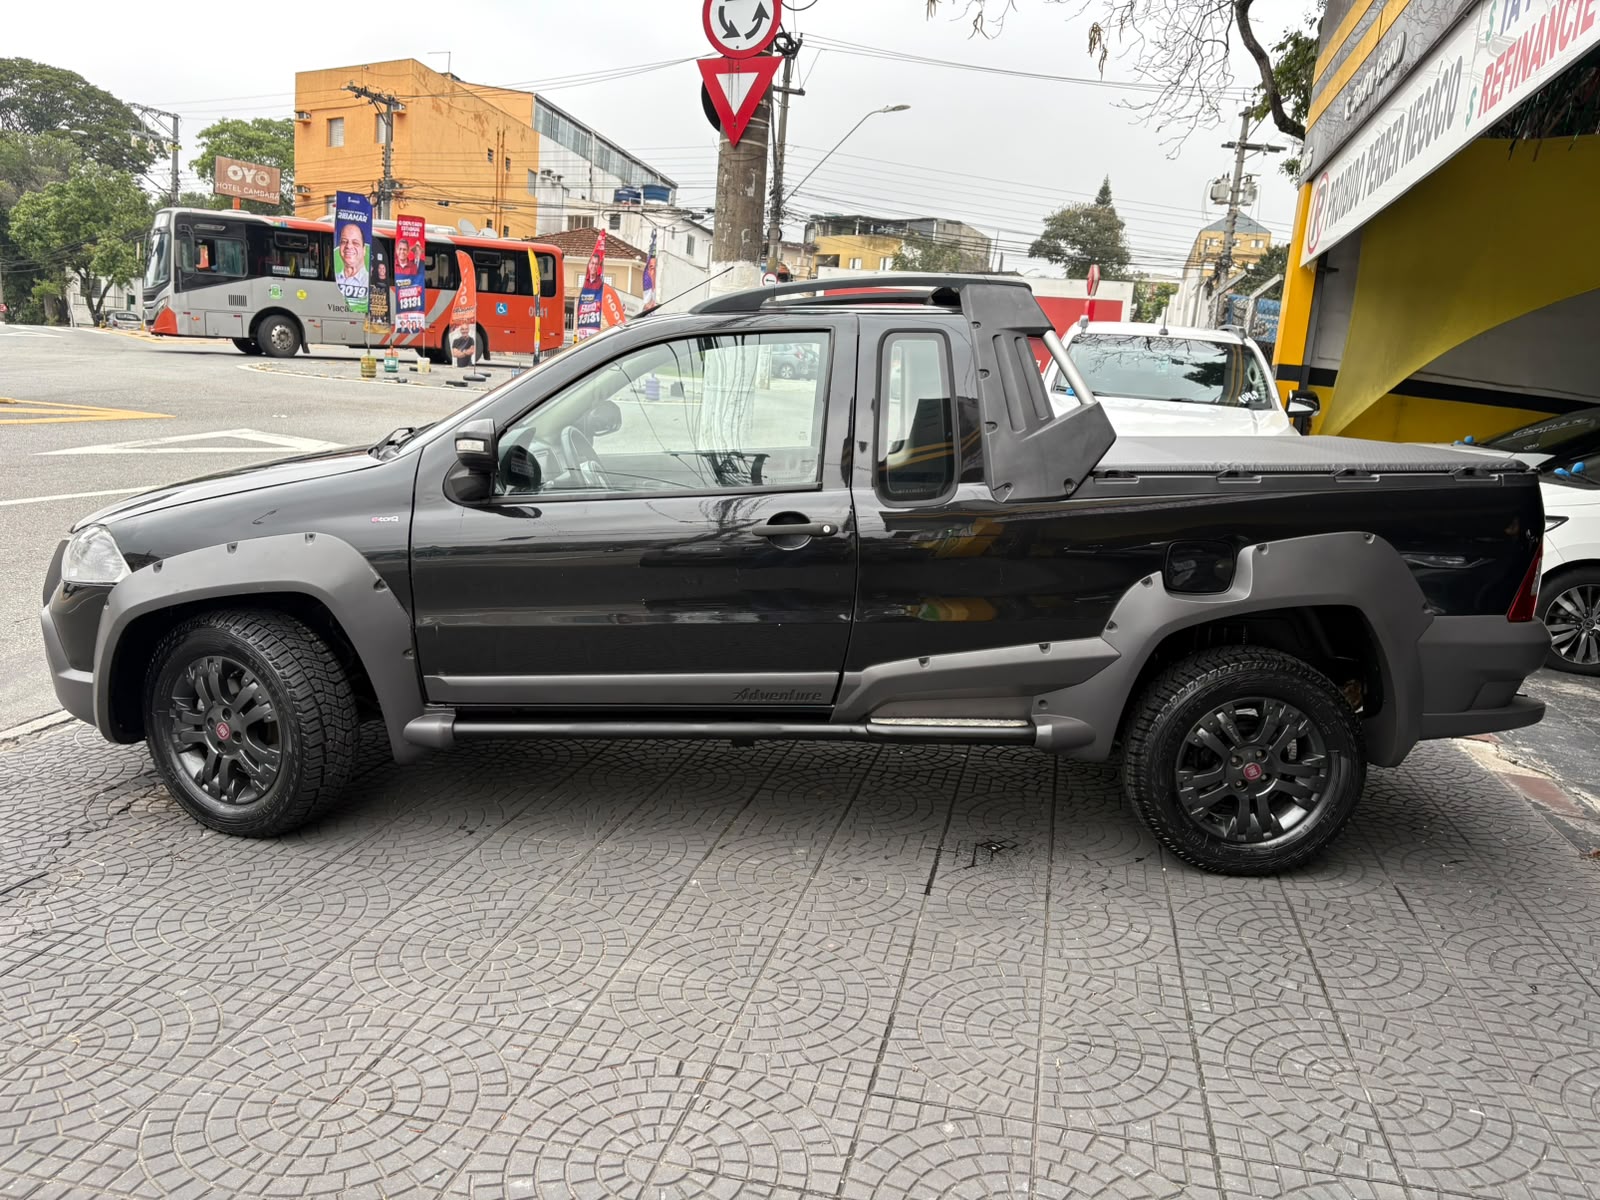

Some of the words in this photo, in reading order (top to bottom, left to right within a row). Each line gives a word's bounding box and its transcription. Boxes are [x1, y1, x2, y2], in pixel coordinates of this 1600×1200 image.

[1477, 0, 1596, 119] REFINANCIE
[1324, 152, 1366, 231] PROIBIDO
[1362, 113, 1405, 201] PERDER
[1401, 55, 1463, 168] NEGÓCIO
[227, 165, 270, 187] OYO
[216, 182, 241, 193] HOTEL
[339, 285, 367, 297] 2019
[400, 296, 421, 309] 13131
[578, 312, 600, 324] 13131
[732, 687, 823, 701] Adventure
